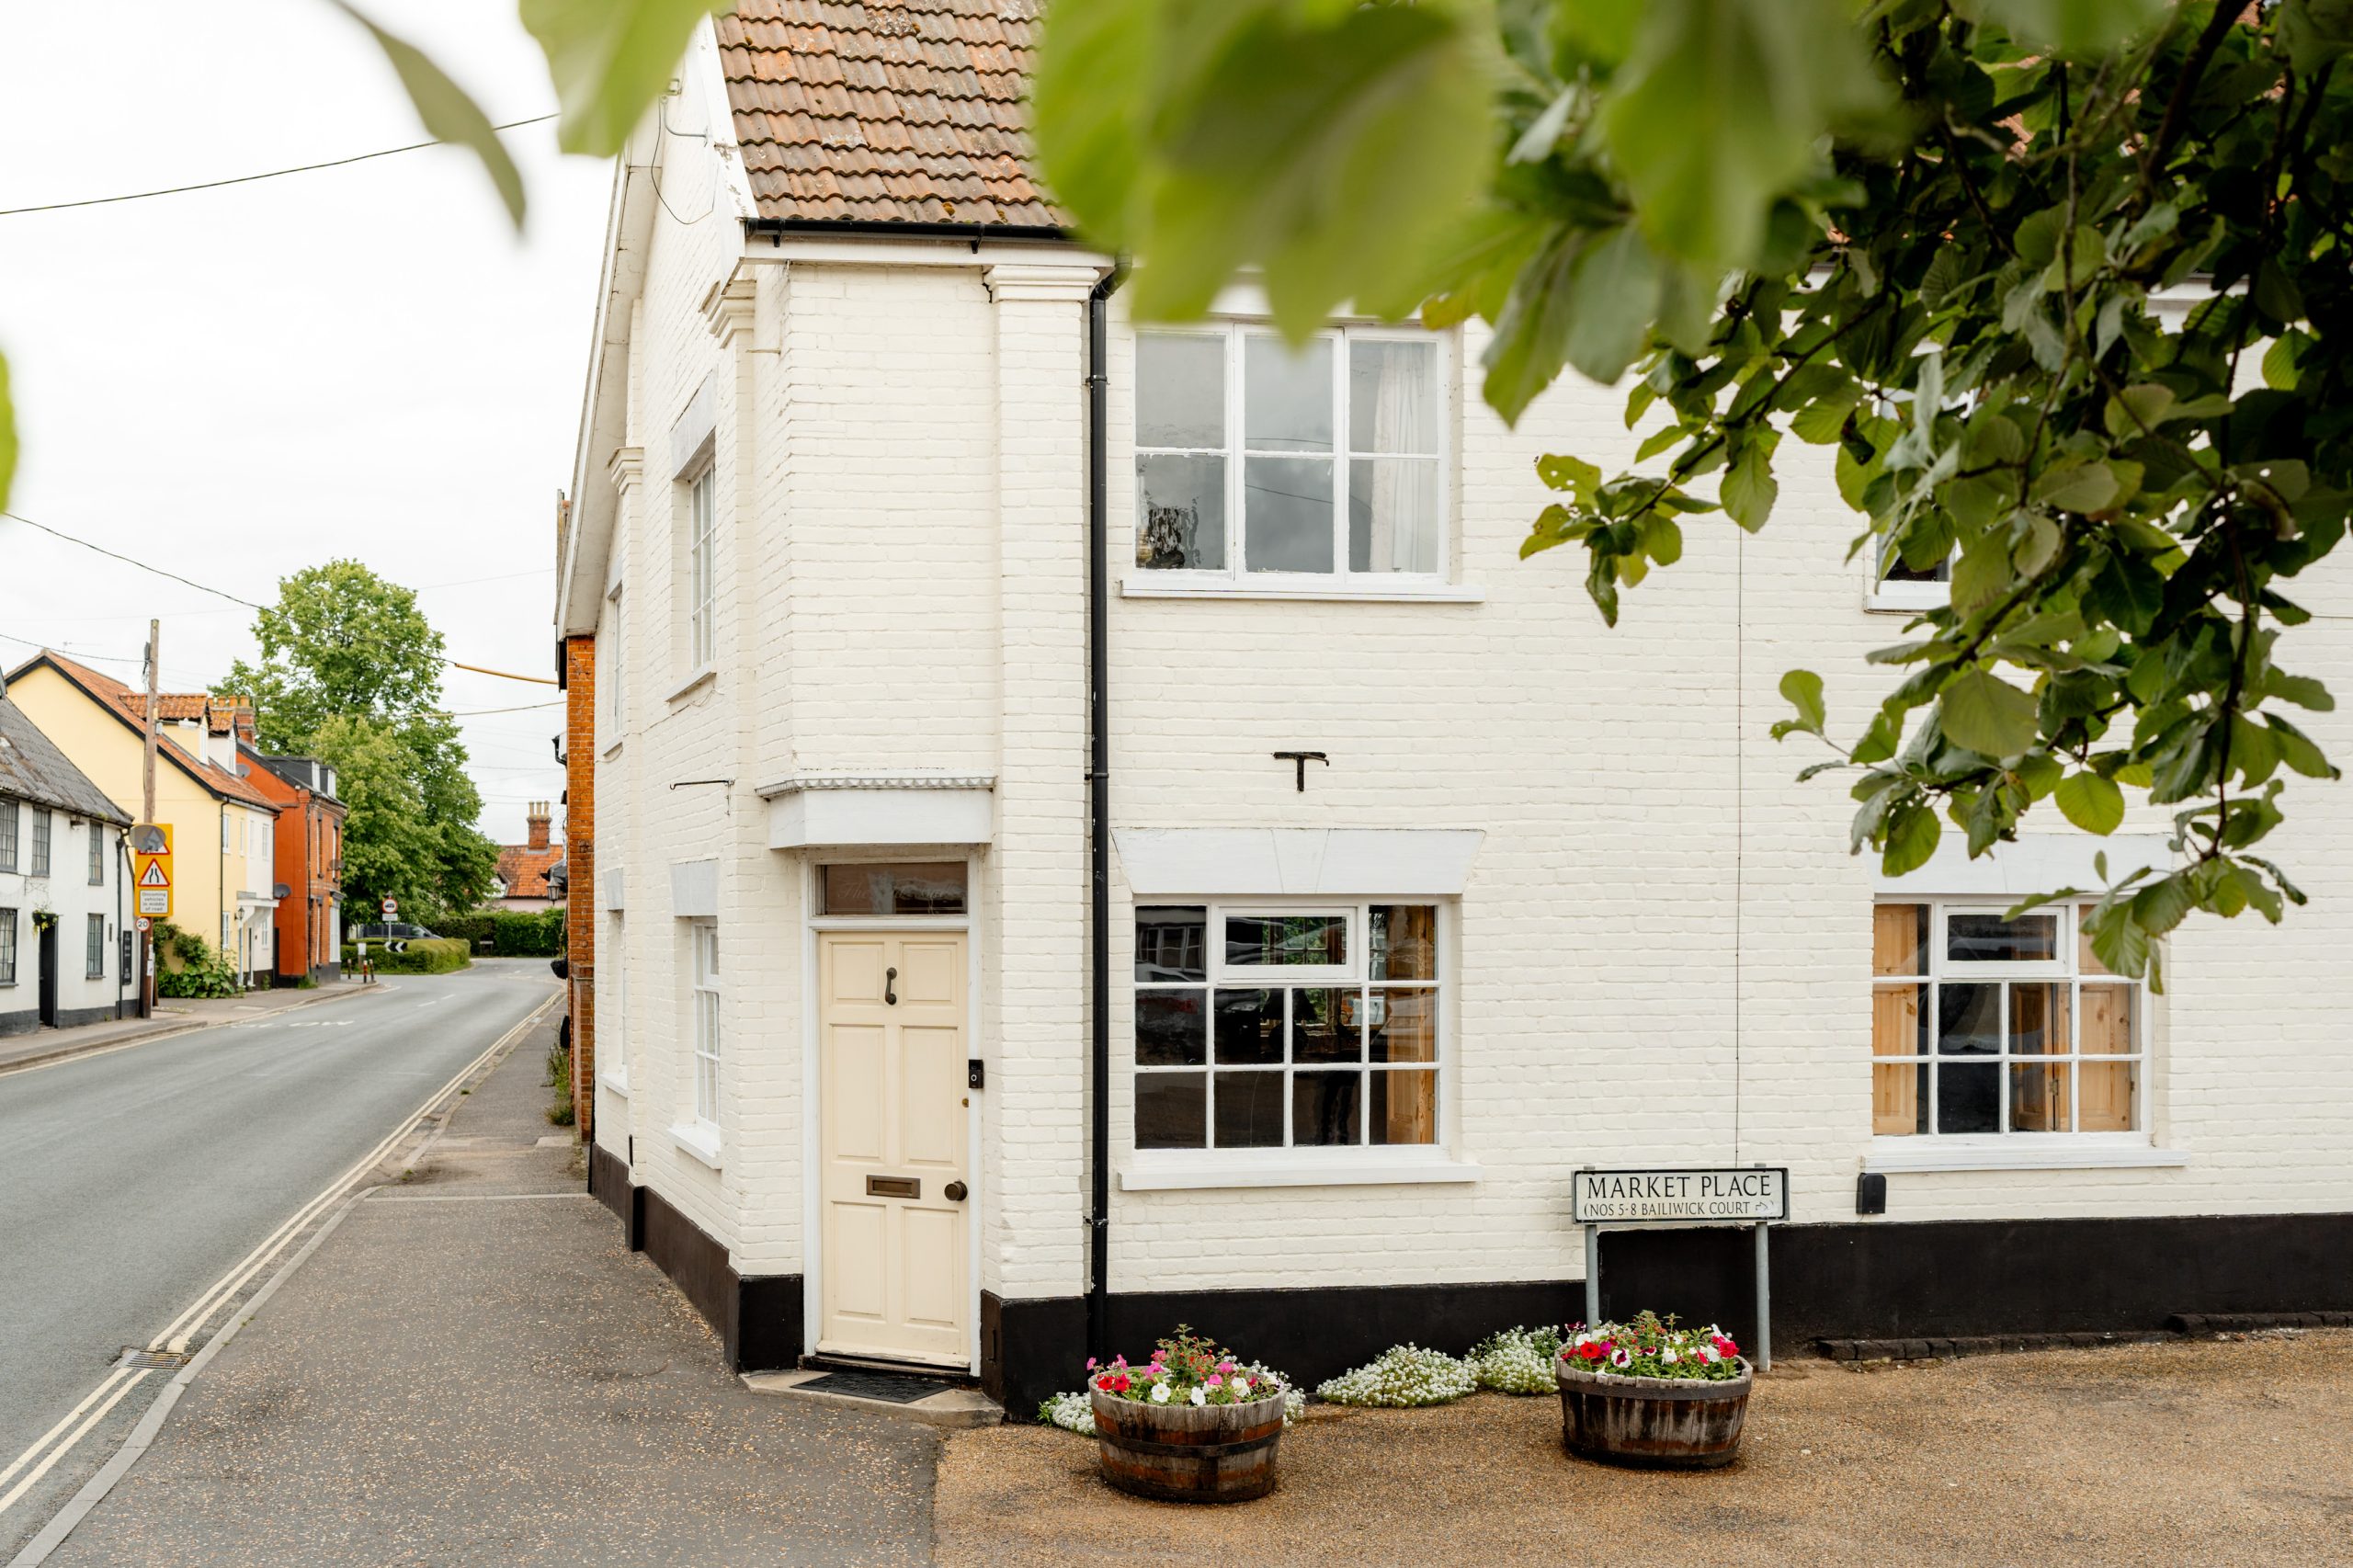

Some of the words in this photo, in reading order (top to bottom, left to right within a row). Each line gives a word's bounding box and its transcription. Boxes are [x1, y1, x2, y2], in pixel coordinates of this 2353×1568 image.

[1587, 1176, 1690, 1199] MARKET
[1701, 1175, 1771, 1197] PLACE
[1584, 1202, 1614, 1218] (NOS
[1618, 1202, 1637, 1216] 5-8
[1642, 1201, 1705, 1216] BAILIWICK
[1709, 1201, 1750, 1214] COURT
